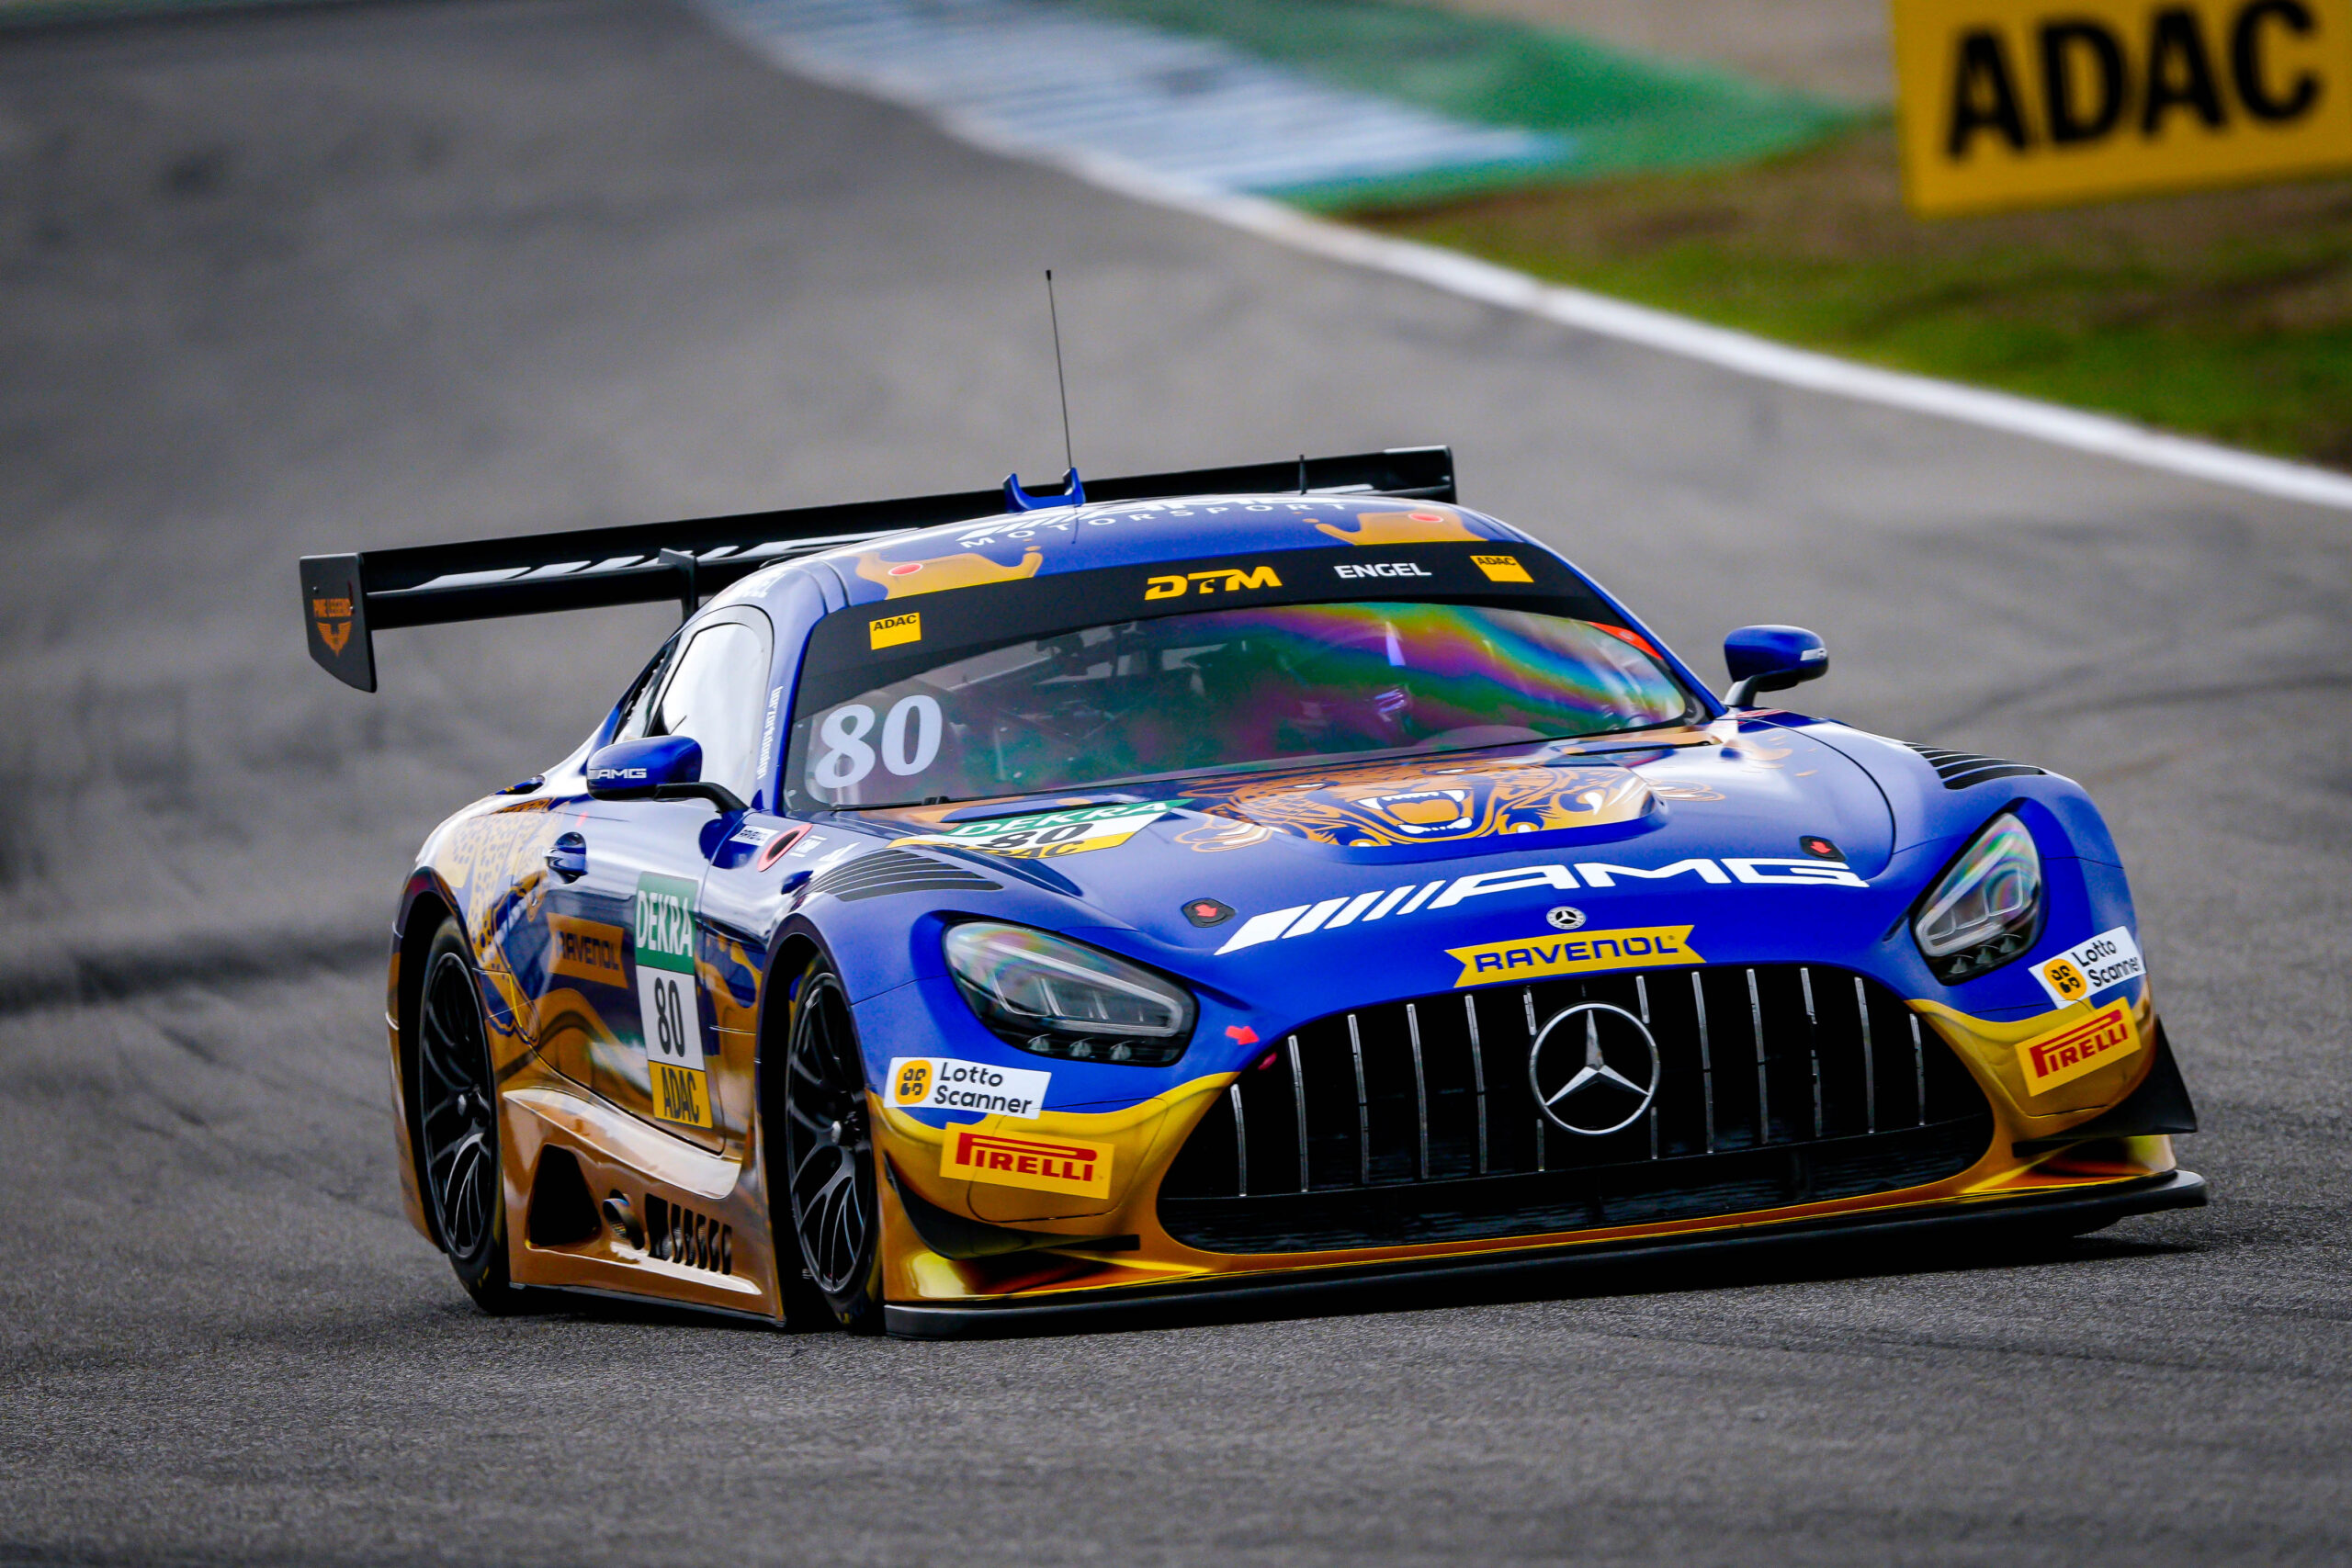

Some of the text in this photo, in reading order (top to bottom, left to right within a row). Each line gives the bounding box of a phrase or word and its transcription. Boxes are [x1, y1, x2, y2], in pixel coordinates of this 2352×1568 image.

[1943, 0, 2322, 164] ADAC
[957, 503, 1347, 548] MOTORSPORT
[1333, 563, 1432, 580] ENGEL
[1476, 557, 1517, 566] ADAC
[1144, 566, 1283, 601] DTM
[873, 614, 918, 632] ADAC
[814, 694, 943, 789] 80
[597, 768, 647, 779] AMG
[950, 802, 1169, 837] DEKRA
[976, 823, 1095, 848] 80
[1427, 857, 1871, 908] AMG
[636, 889, 694, 957] DEKRA
[555, 930, 619, 970] RAVENOL
[1474, 935, 1679, 973] RAVENOL
[2071, 940, 2118, 968] Lotto
[2087, 956, 2140, 987] Scanner
[654, 977, 685, 1057] 80
[2029, 1009, 2129, 1078] PIRELLI
[939, 1062, 1003, 1088] Lotto
[661, 1066, 700, 1123] ADAC
[933, 1085, 1034, 1114] Scanner
[956, 1132, 1098, 1182] PIRELLI
